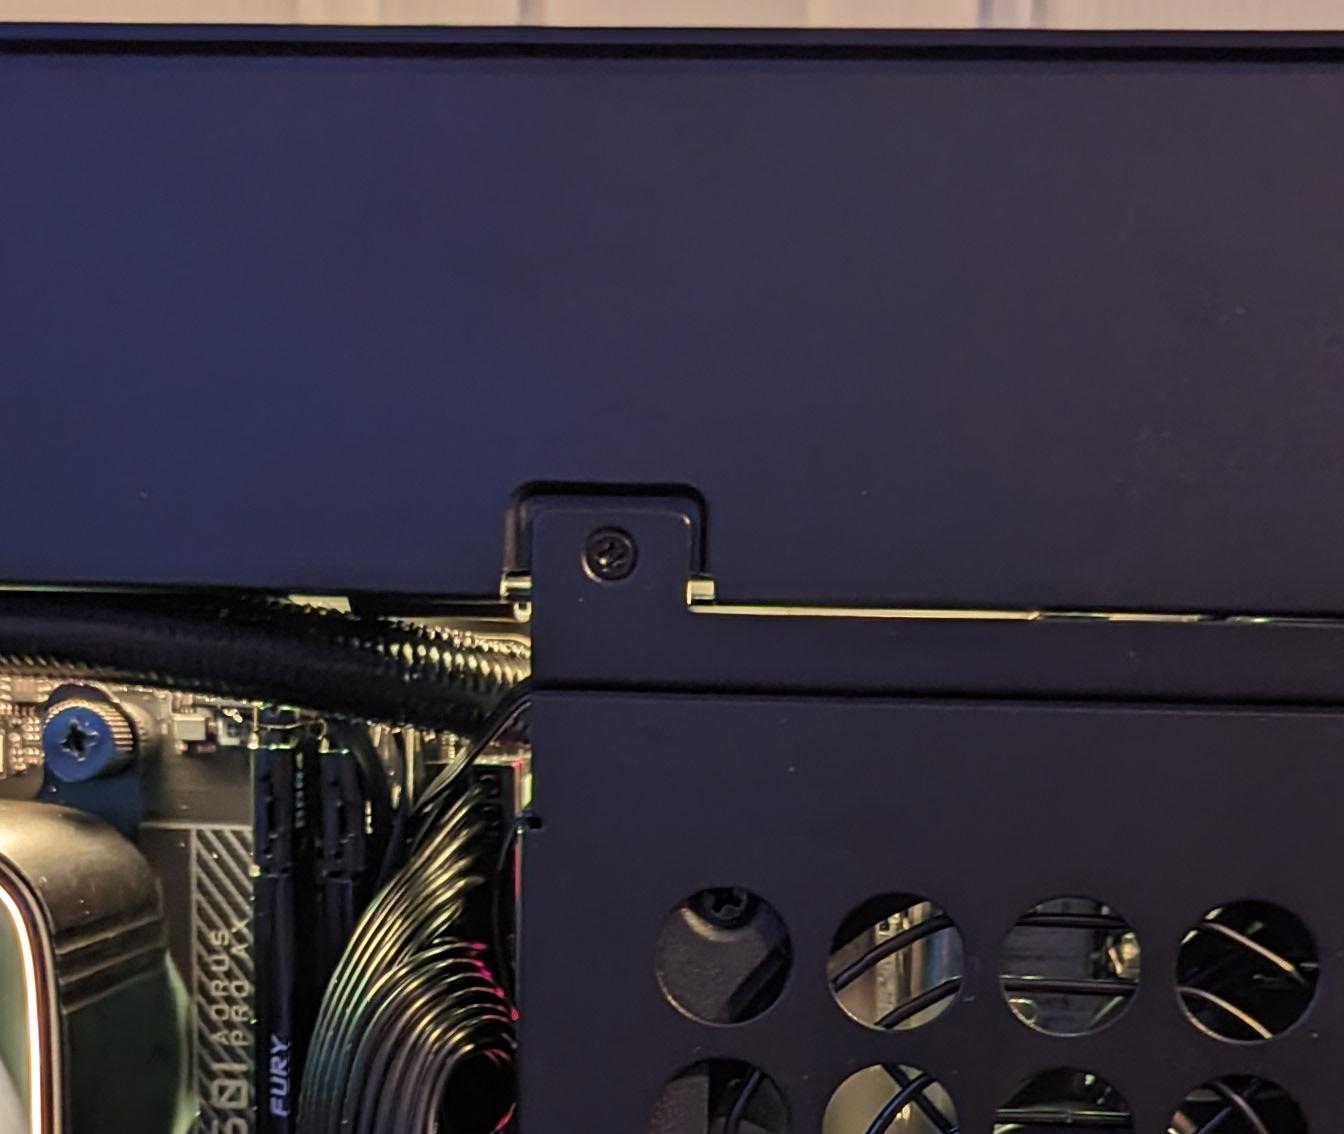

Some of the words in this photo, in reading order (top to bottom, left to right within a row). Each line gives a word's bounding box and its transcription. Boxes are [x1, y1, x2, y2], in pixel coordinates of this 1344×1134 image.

[232, 916, 250, 958] AX
[210, 929, 230, 1045] AORUS
[231, 979, 250, 1046] PRO
[270, 1035, 290, 1117] FURY
